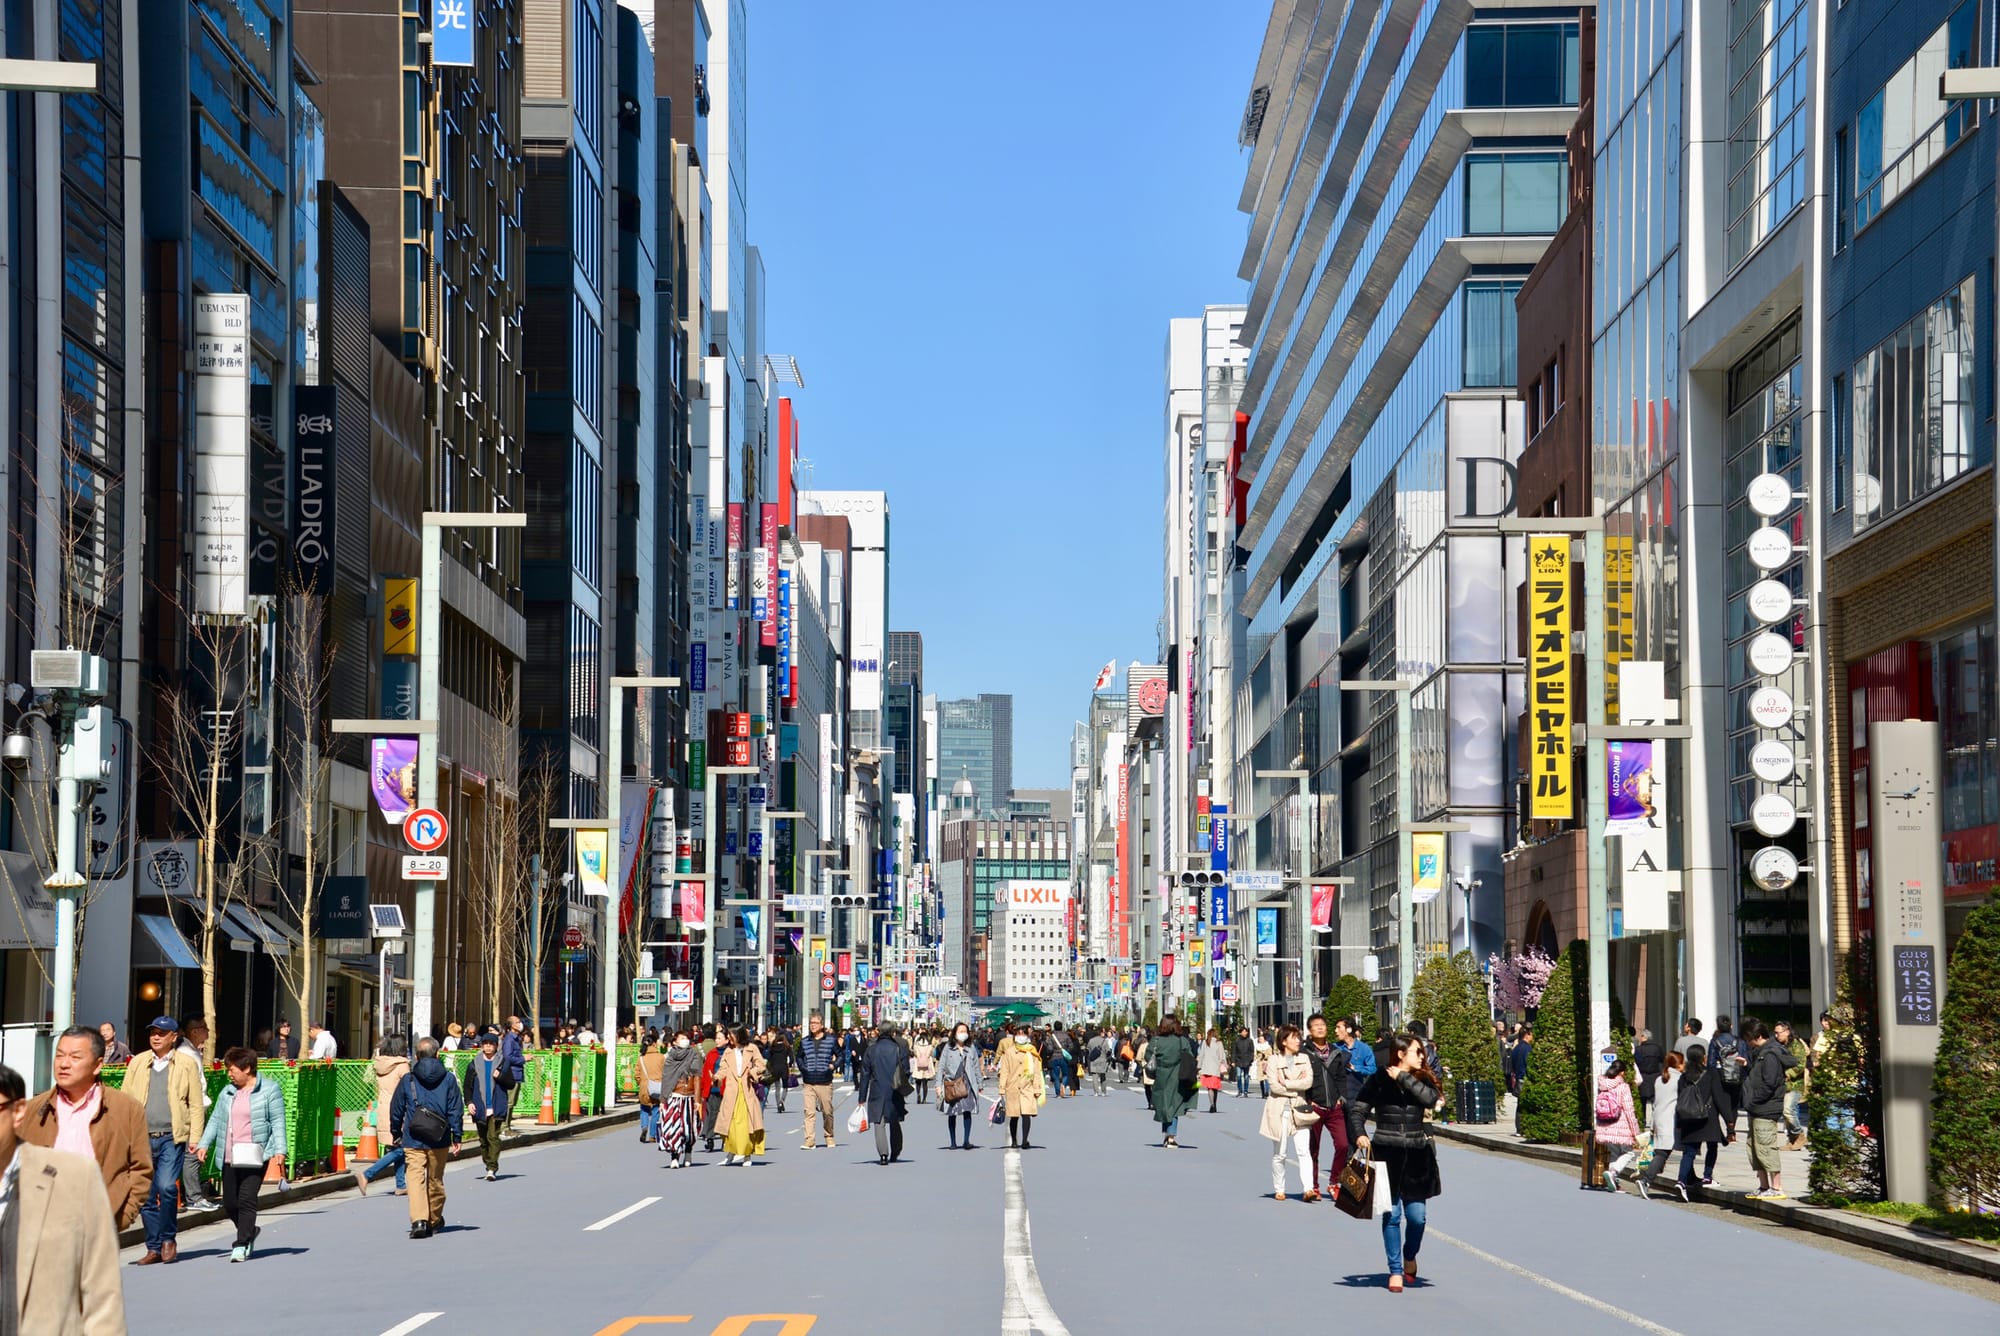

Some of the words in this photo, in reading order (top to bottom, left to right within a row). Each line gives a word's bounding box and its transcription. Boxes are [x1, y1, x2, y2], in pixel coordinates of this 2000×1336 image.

[438, 0, 467, 29] 光
[200, 303, 241, 313] UEMATSU
[224, 319, 242, 328] BLD
[199, 357, 243, 368] 法律事務所
[296, 448, 329, 564] LLADRÓ
[1535, 581, 1566, 798] ライオンビヤホール
[1756, 706, 1788, 714] OMEGA
[729, 744, 746, 752] UNI
[729, 753, 747, 762] QLO
[376, 752, 385, 790] #RWC2019
[1611, 754, 1620, 797] #RWC2019
[1235, 875, 1279, 884] 銀座六丁目
[1013, 888, 1060, 904] LIXIL
[1899, 951, 1928, 959] 2018
[1916, 1013, 1931, 1022] 43
